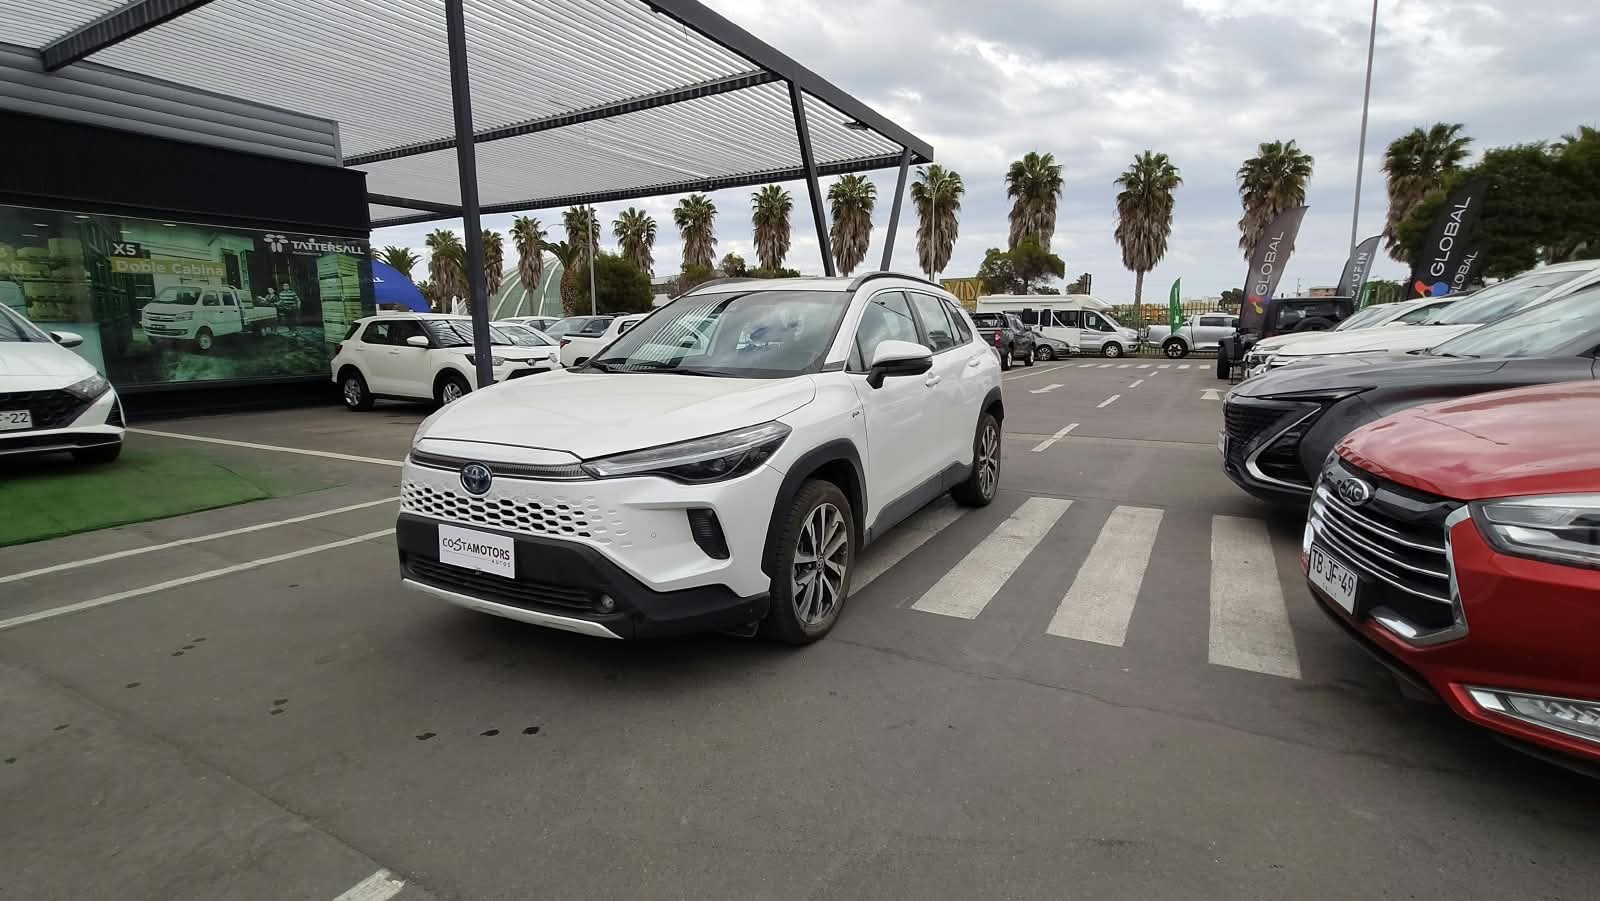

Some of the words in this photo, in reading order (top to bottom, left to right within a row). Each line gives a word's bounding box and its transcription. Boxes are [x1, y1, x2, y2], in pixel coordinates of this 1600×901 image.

[1430, 196, 1471, 277] GLOBAL
[113, 243, 136, 256] X5
[290, 240, 365, 255] TATTERSALL
[115, 260, 166, 273] Doble
[172, 263, 224, 275] Cabina
[1256, 231, 1284, 296] GLOBAL
[442, 538, 510, 560] COSTAMOTORS
[492, 560, 510, 568] AUTOS
